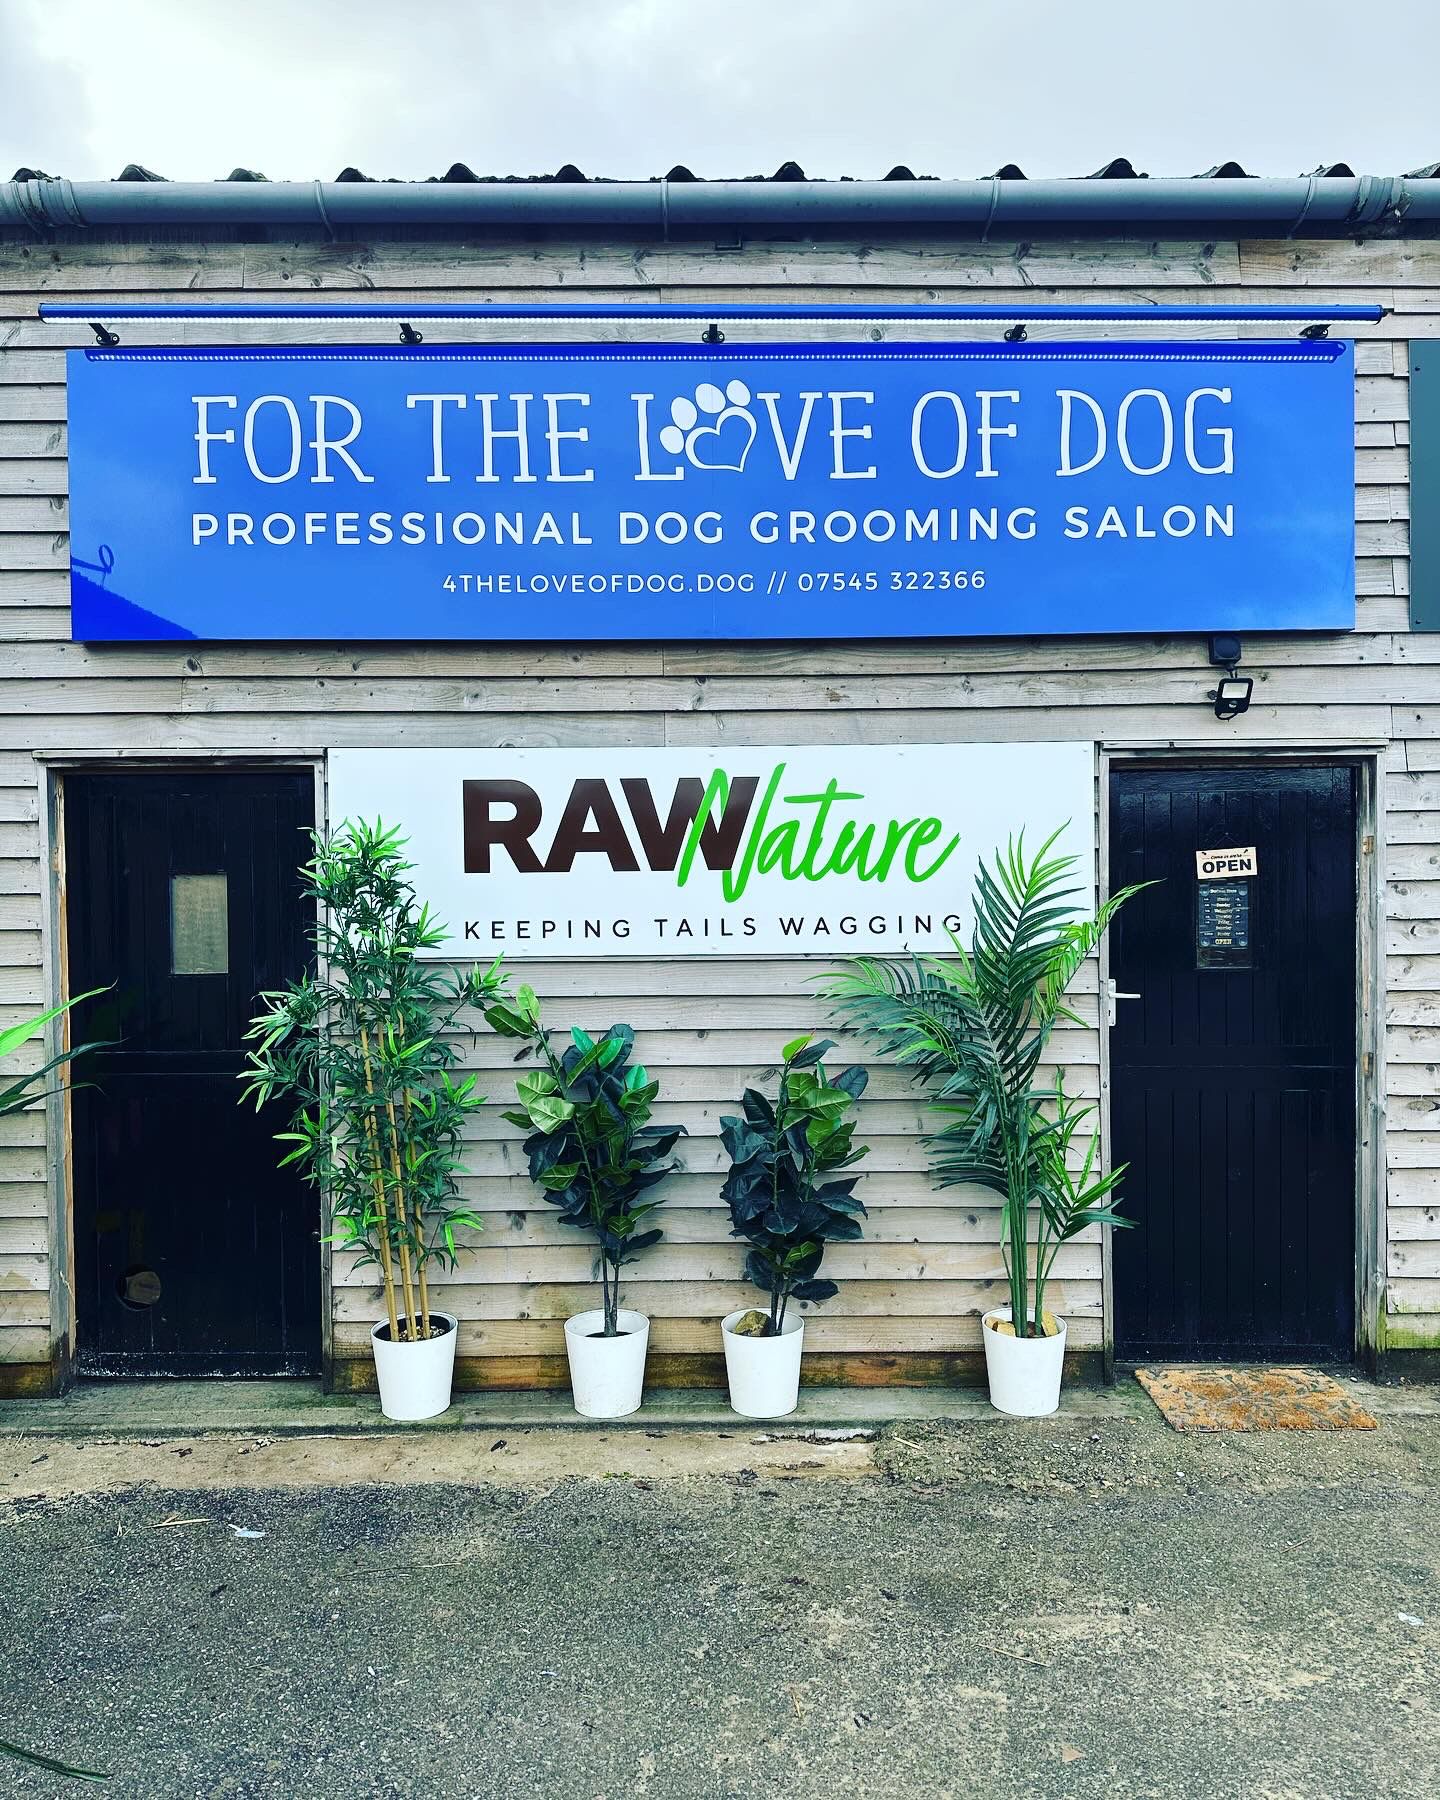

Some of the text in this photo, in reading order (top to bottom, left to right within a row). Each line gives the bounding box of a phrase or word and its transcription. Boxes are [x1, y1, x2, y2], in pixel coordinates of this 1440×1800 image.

[192, 395, 374, 484] FOR
[407, 393, 594, 483] THE
[911, 390, 1020, 479] OF
[1055, 387, 1235, 477] DOG
[192, 504, 1235, 546] PROFESSIONAL DOG GROOMING SALON
[442, 574, 755, 593] 4THELOVEOFDOG.DOG
[798, 572, 878, 592] 07545
[890, 570, 986, 590] 322366
[463, 762, 961, 903] RAW Nature
[1202, 858, 1252, 874] OPEN
[465, 914, 962, 940] KEEPING TAILS WAGGING
